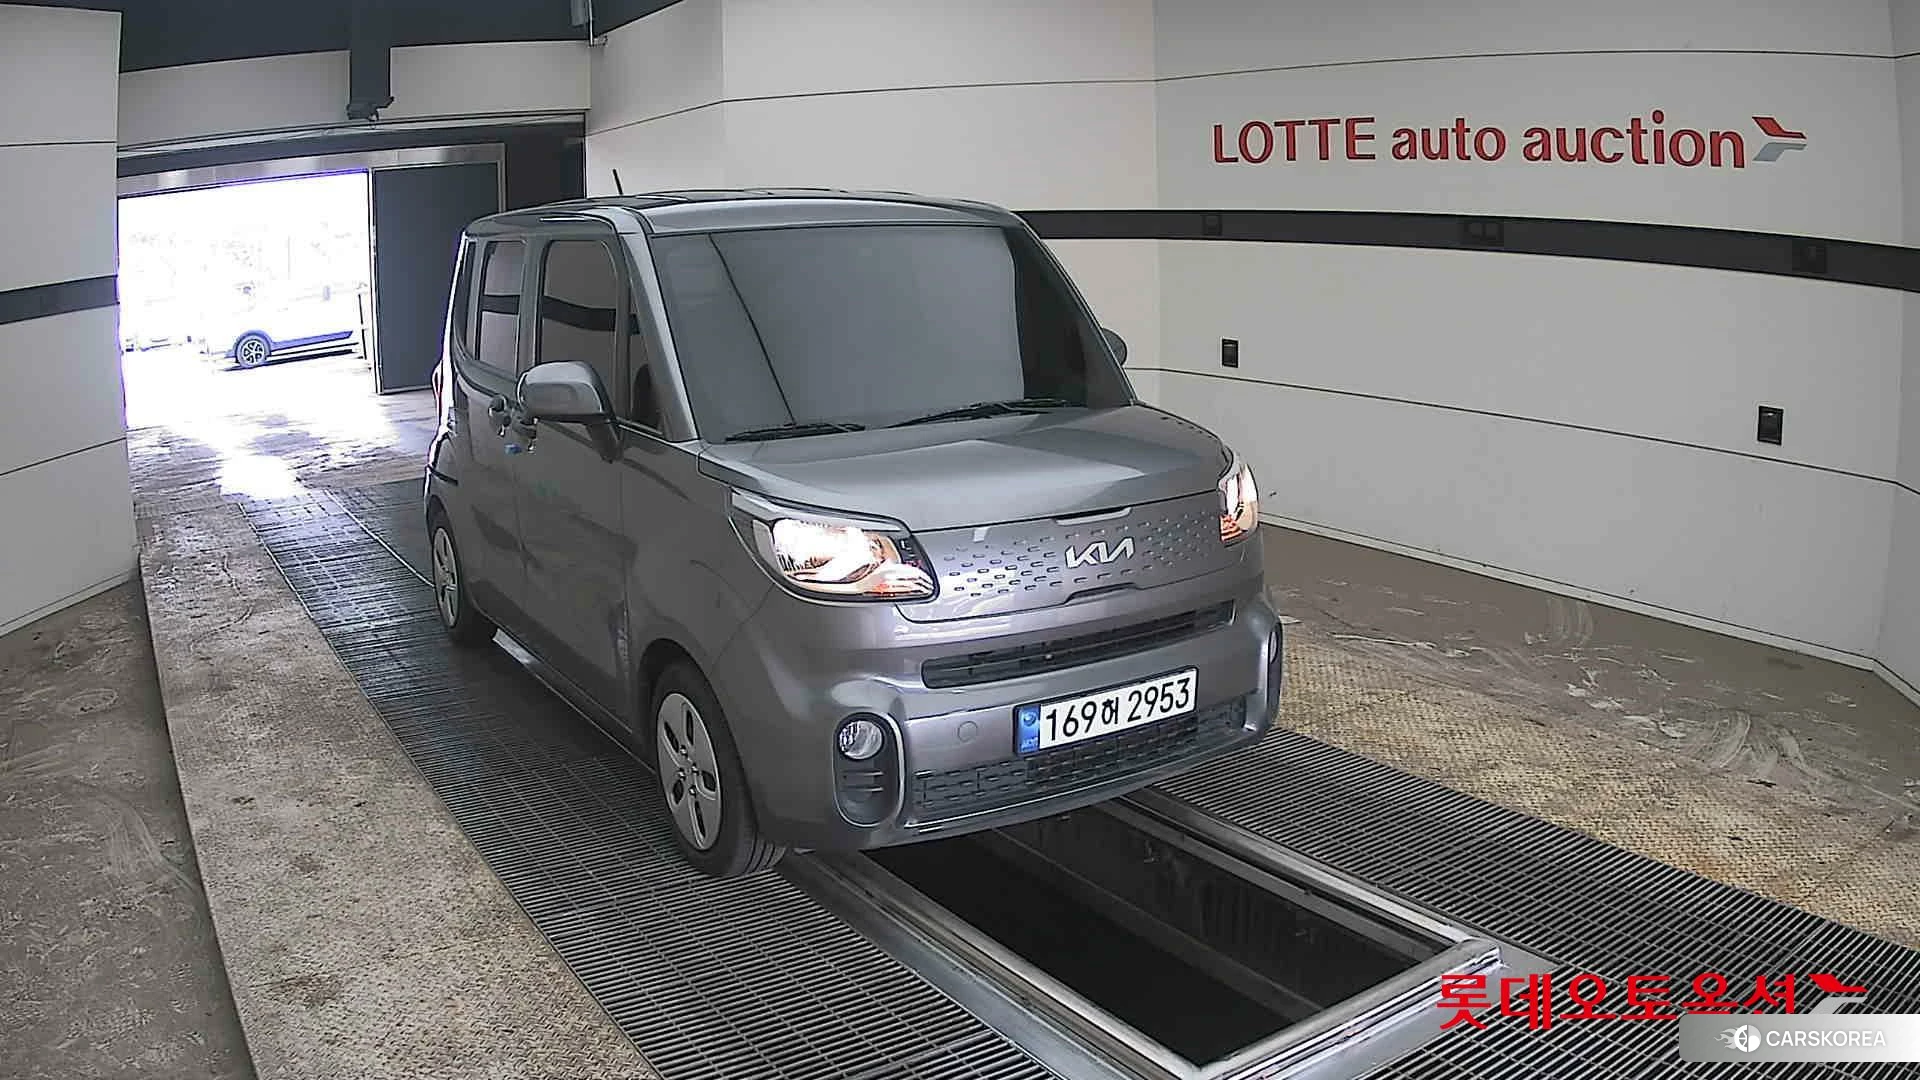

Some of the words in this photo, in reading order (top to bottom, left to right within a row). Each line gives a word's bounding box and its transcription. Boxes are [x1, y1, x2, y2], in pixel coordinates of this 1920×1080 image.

[1213, 117, 1376, 163] LOTTE
[1392, 118, 1507, 161] auto
[1522, 110, 1745, 168] auction
[1065, 537, 1134, 568] KIA
[1127, 677, 1191, 723] 2953
